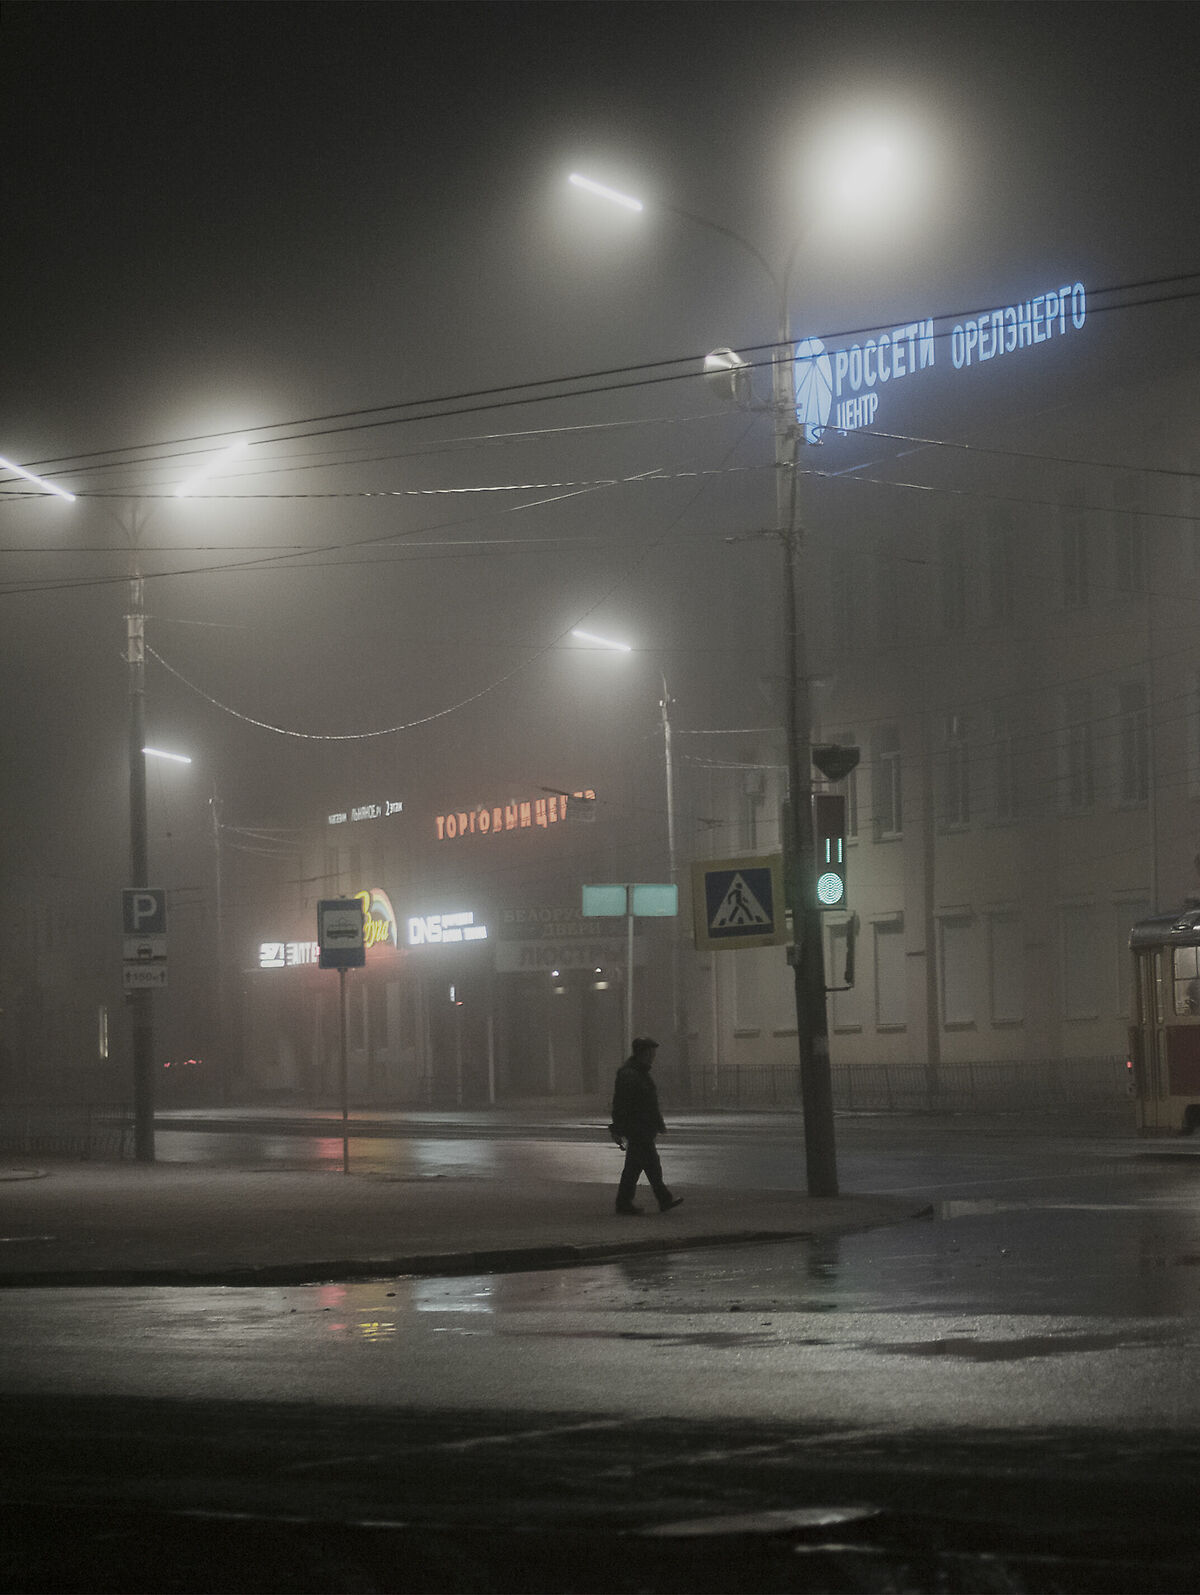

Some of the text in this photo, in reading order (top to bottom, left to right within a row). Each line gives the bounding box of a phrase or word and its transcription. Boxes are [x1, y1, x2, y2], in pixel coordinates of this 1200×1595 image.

[835, 281, 1086, 396] РОССЕТИ ОРЕЛЭНЕРГО
[836, 392, 879, 435] ЦЕНТР
[535, 789, 596, 829] ЦЕН
[133, 894, 158, 929] P
[408, 915, 441, 944] DNS
